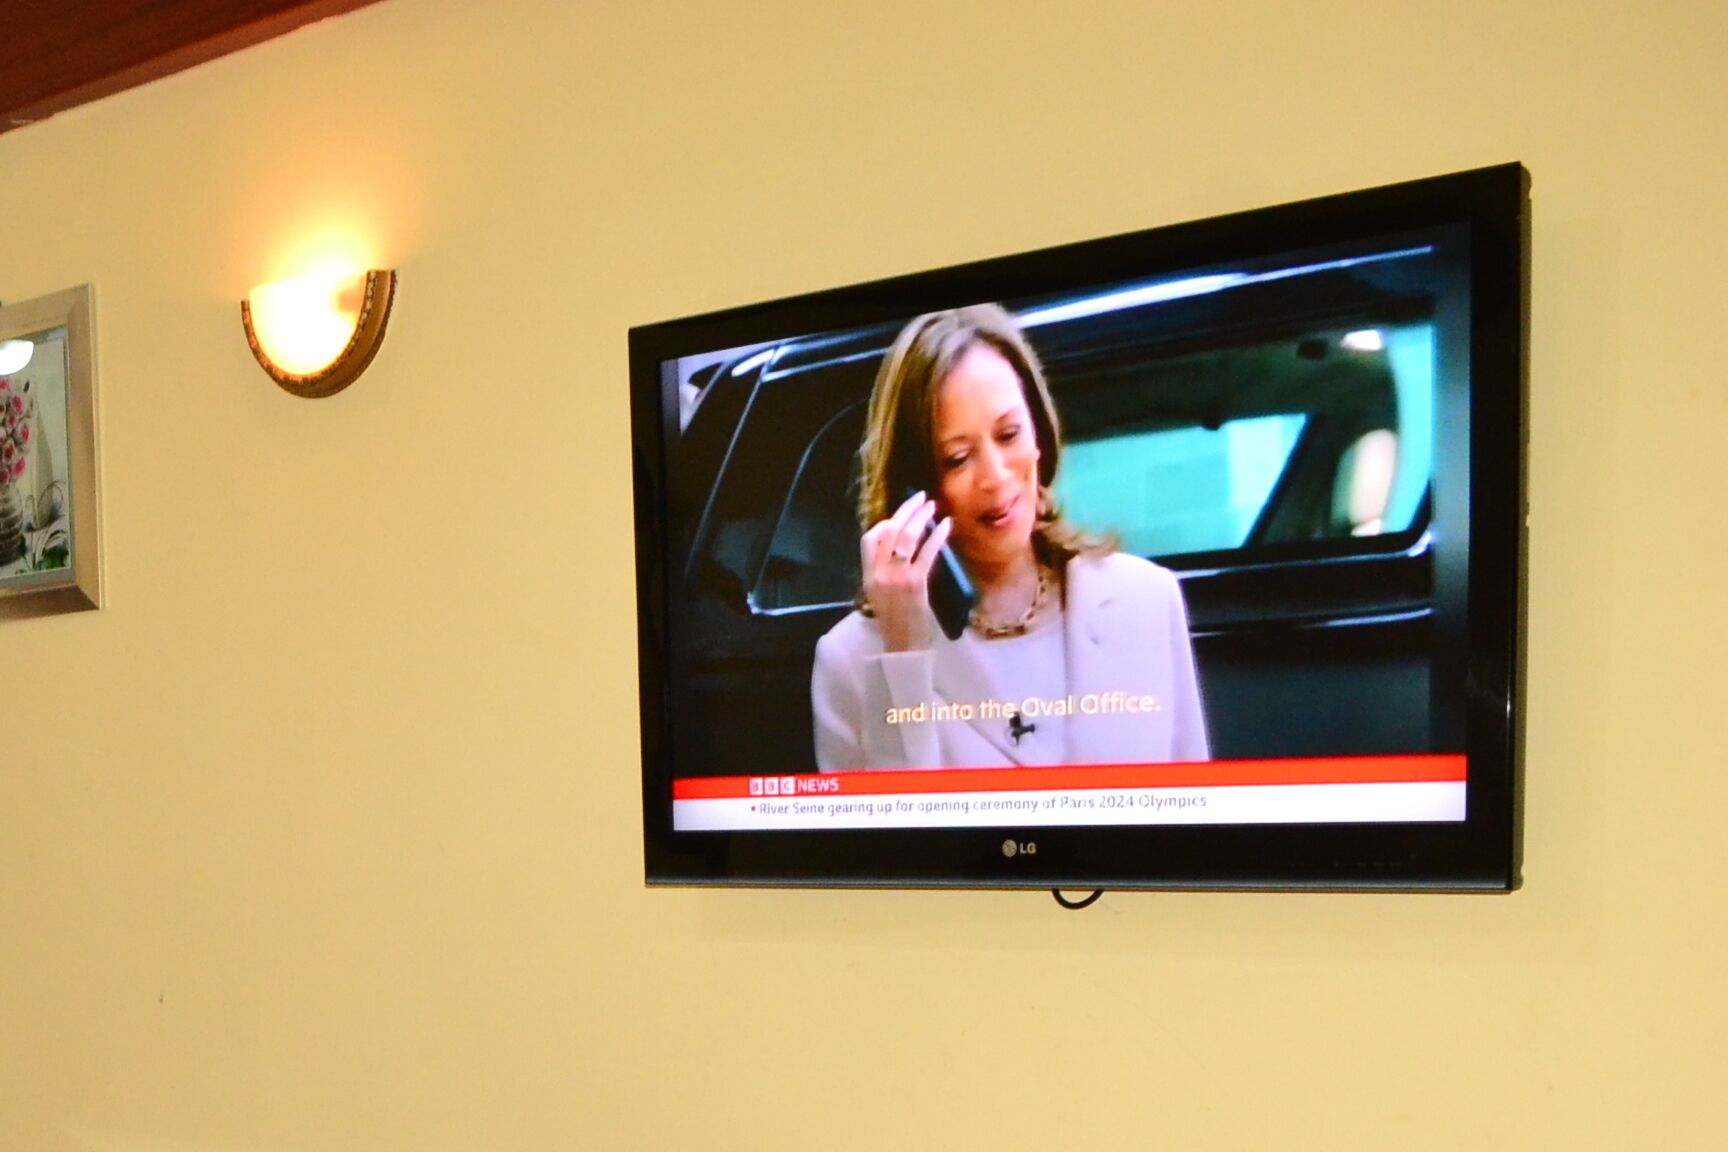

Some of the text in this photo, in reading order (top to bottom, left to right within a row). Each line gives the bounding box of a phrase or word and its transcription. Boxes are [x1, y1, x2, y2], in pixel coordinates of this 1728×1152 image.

[886, 692, 1162, 724] and into the Oval Office.
[749, 777, 840, 796] BBC NEWS
[759, 794, 1208, 816] River Seine gearing up for opening ceremony of Paris 2024 Olympics
[1019, 842, 1037, 855] LG
